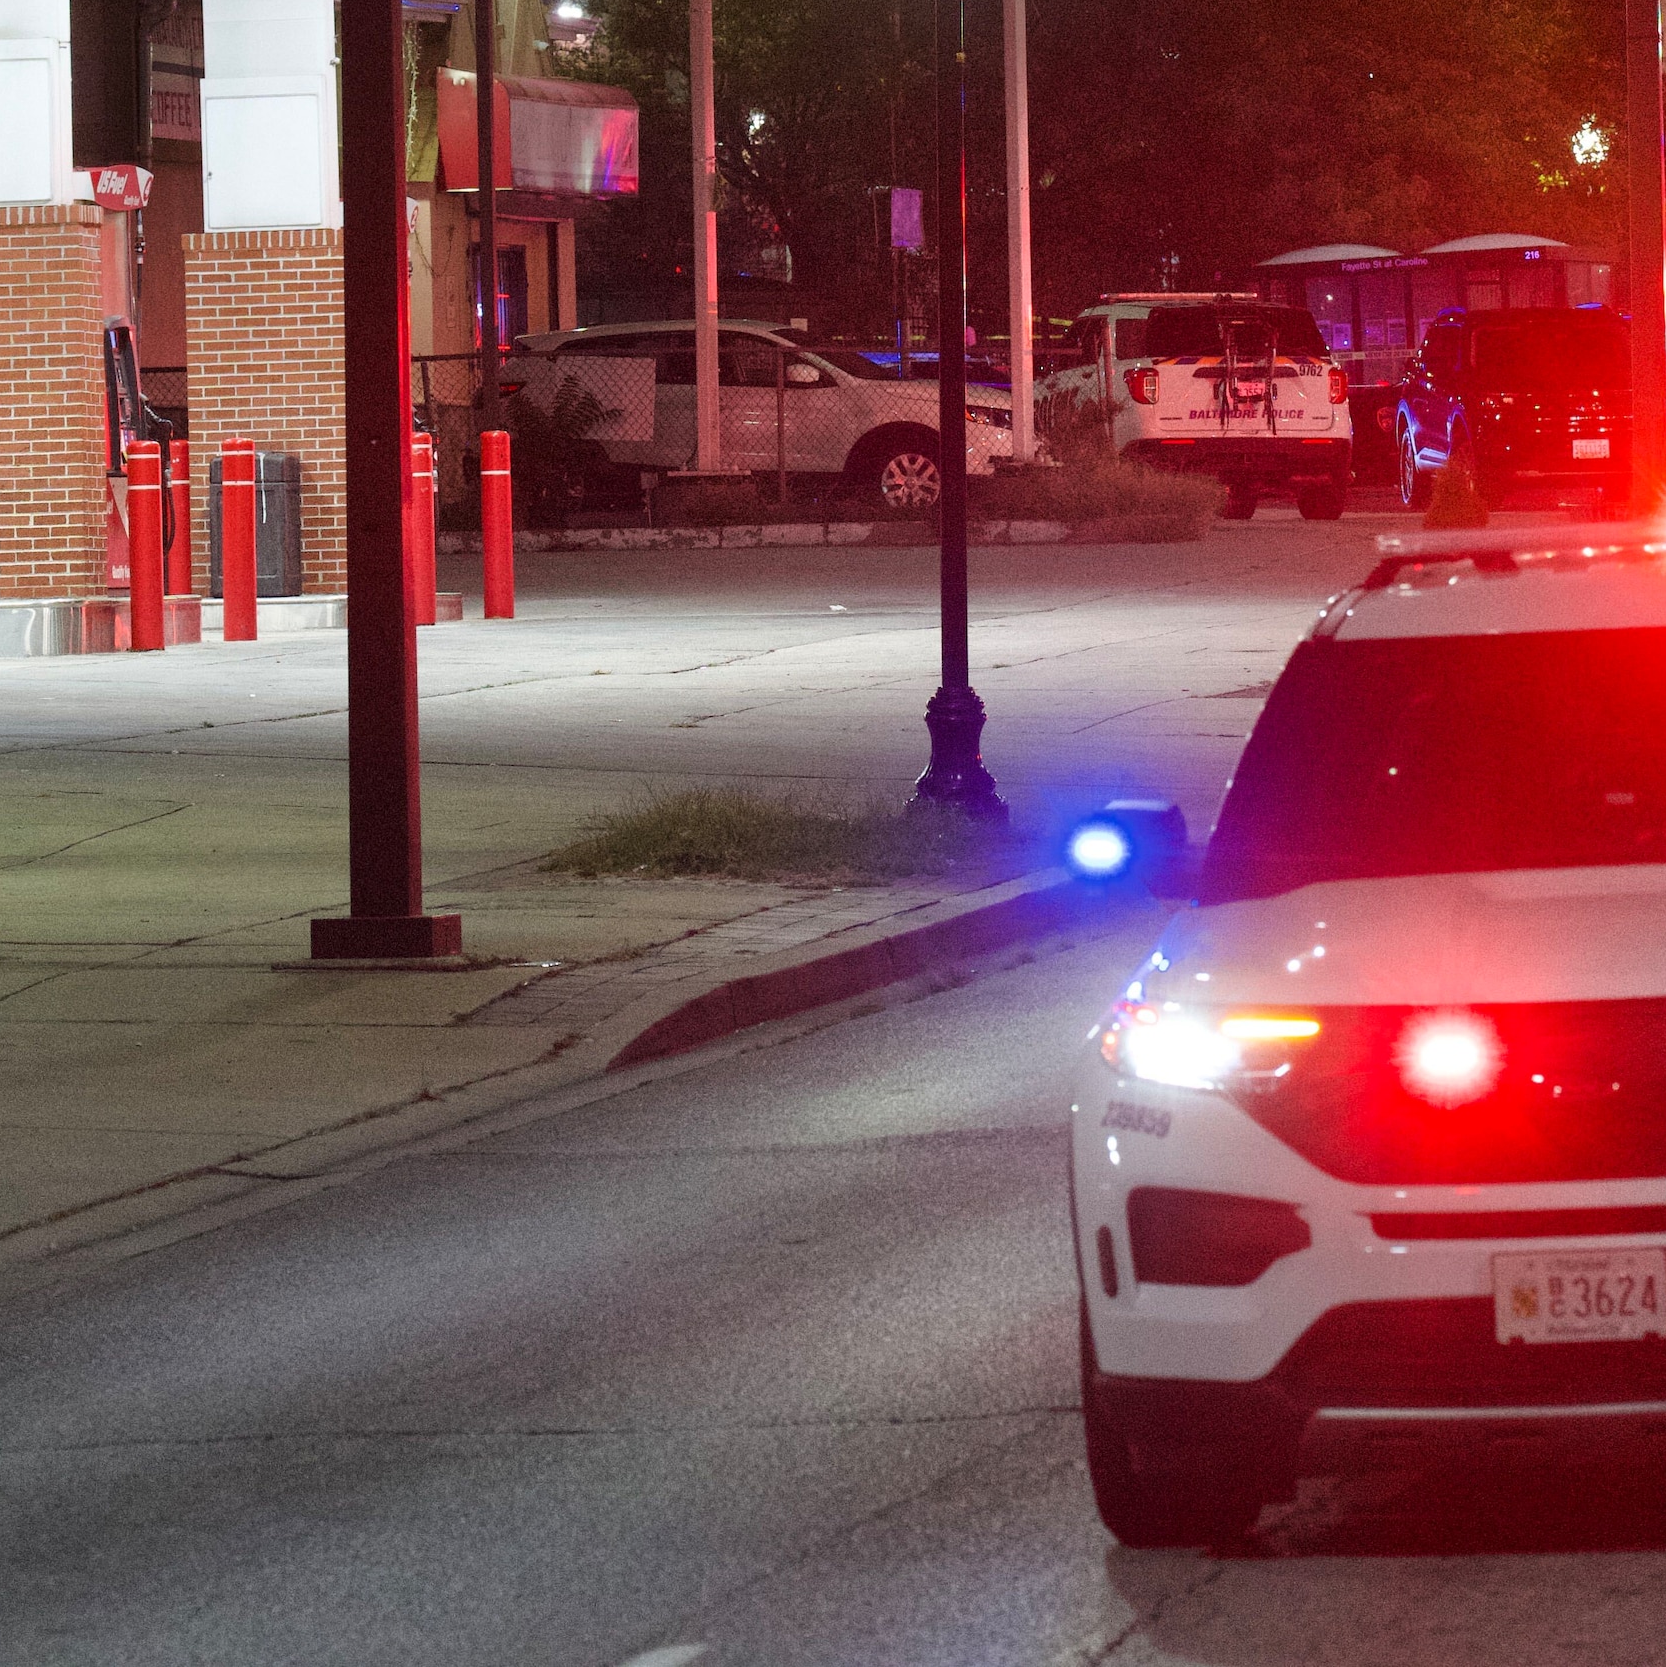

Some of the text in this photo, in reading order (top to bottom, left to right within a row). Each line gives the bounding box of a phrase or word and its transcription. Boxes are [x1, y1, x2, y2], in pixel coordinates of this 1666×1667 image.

[1524, 250, 1540, 260] 216
[1341, 256, 1428, 273] Fayette St at Caroline
[1299, 364, 1323, 377] 9762
[1573, 1273, 1658, 1319] 3624
